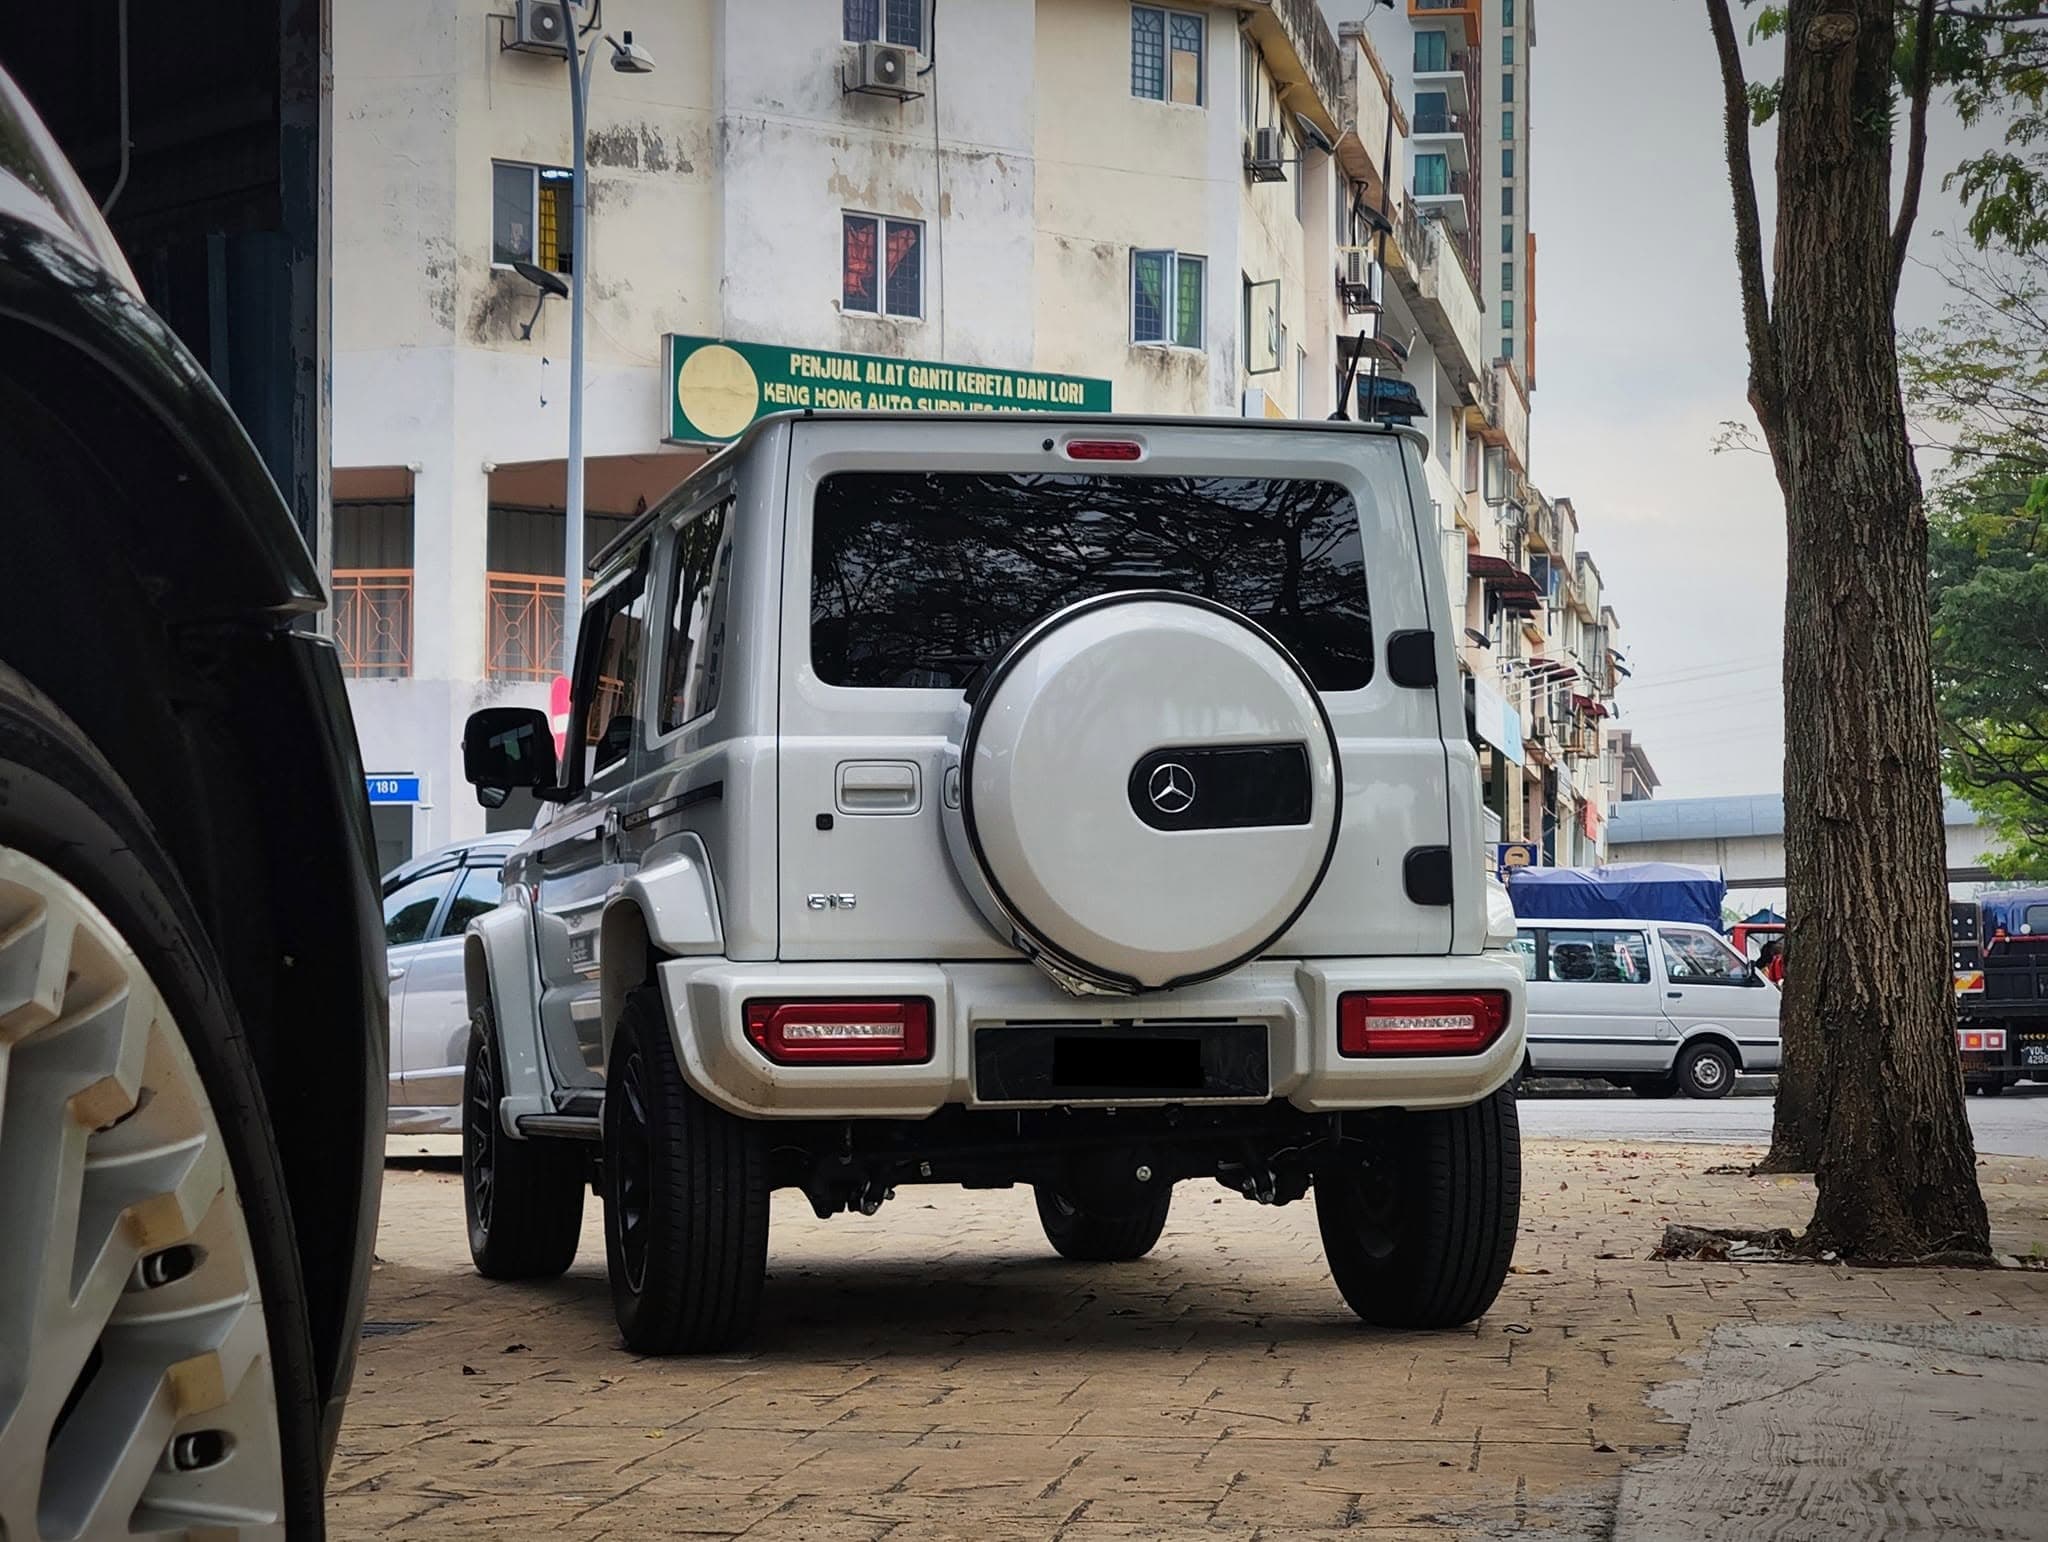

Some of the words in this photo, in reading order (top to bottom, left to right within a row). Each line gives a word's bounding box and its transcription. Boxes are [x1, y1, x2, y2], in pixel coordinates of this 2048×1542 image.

[790, 353, 861, 382] PENJUAL
[866, 361, 904, 386] ALAT
[908, 366, 953, 391] GANTI
[956, 371, 1013, 398] KERETA
[1017, 377, 1048, 401] DAN
[1051, 381, 1084, 404] LORI
[764, 381, 809, 405] KENG
[815, 386, 861, 409] HONG
[867, 392, 912, 410] AUTO
[808, 893, 856, 911] G15
